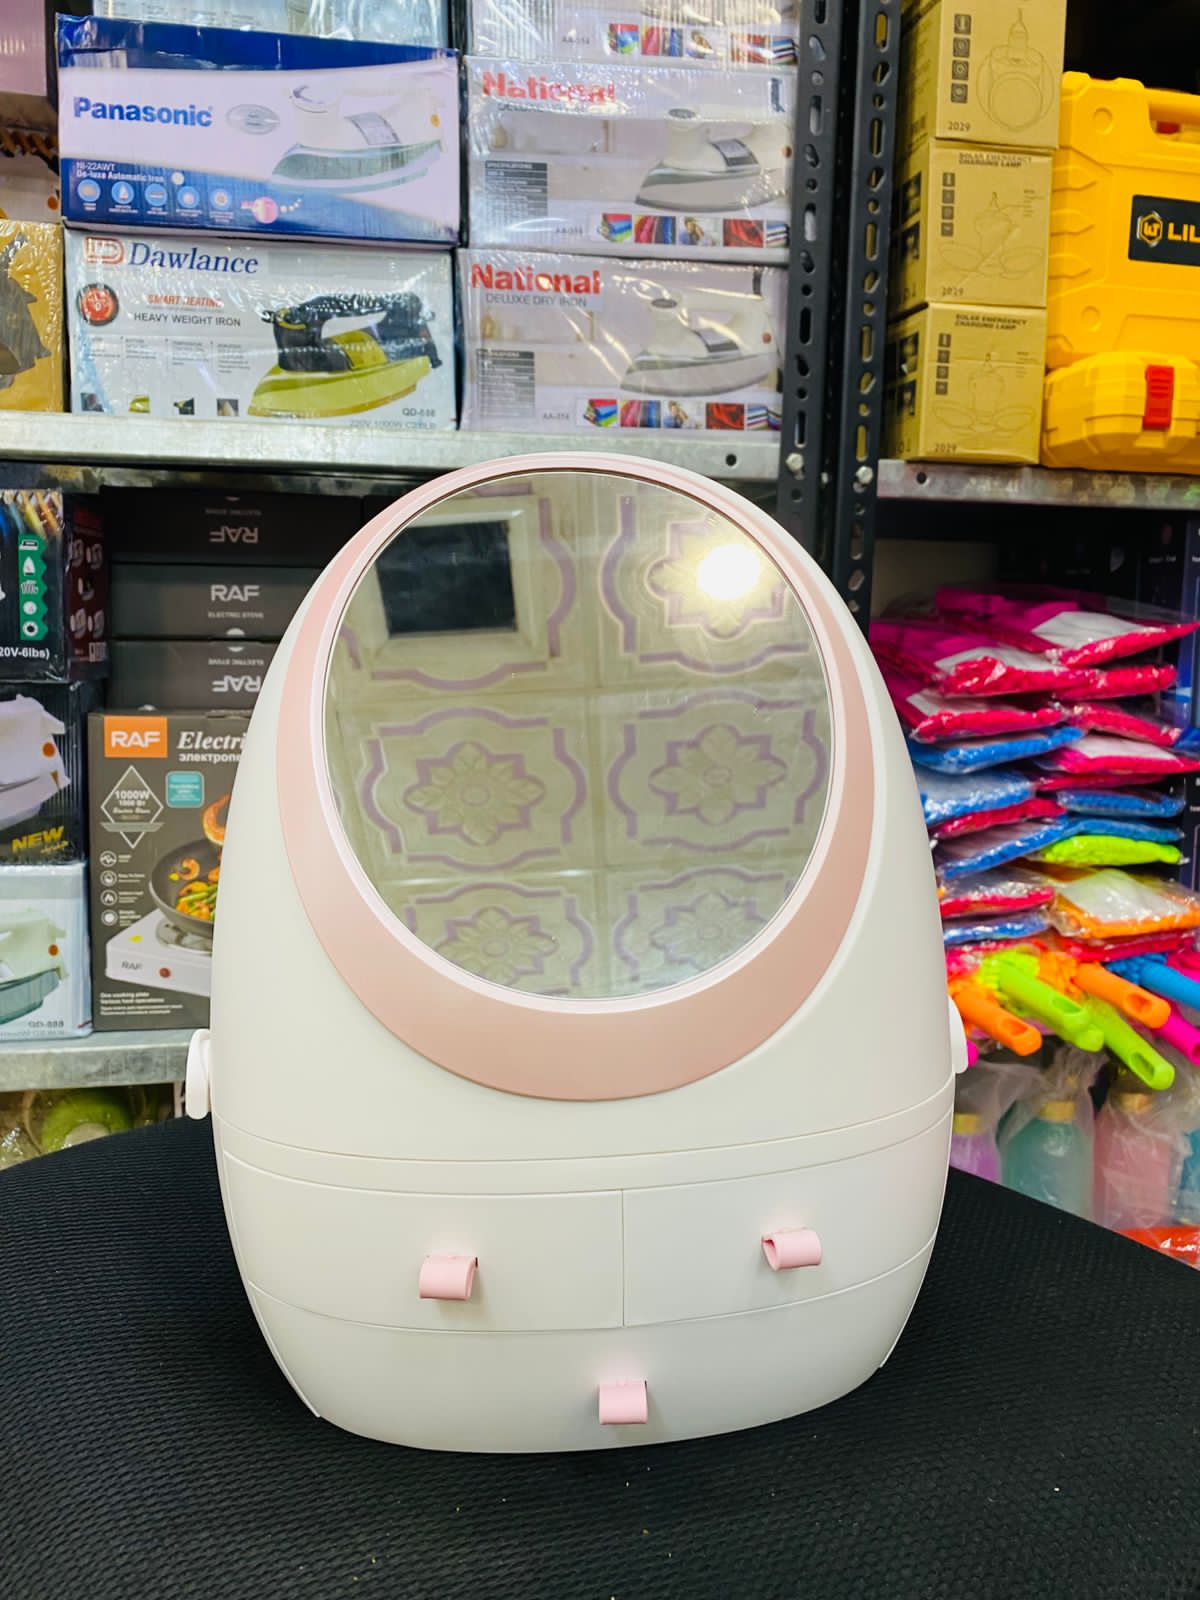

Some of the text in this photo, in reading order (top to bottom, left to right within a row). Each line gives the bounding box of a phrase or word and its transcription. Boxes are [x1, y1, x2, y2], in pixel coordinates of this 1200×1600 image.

[73, 96, 213, 127] Panasonic
[948, 120, 971, 132] 2029
[108, 171, 145, 181] Automatic
[128, 242, 259, 274] Dawlance
[471, 263, 600, 295] National
[486, 292, 529, 305] DELUXE
[532, 295, 554, 306] DRY
[134, 312, 241, 328] HEAVY WEIGHT IRON
[209, 525, 259, 544] RAF
[210, 584, 261, 602] RAF
[211, 674, 261, 692] RAF
[111, 730, 161, 748] RAF
[115, 790, 150, 800] 1000W
[11, 825, 65, 853] NEW
